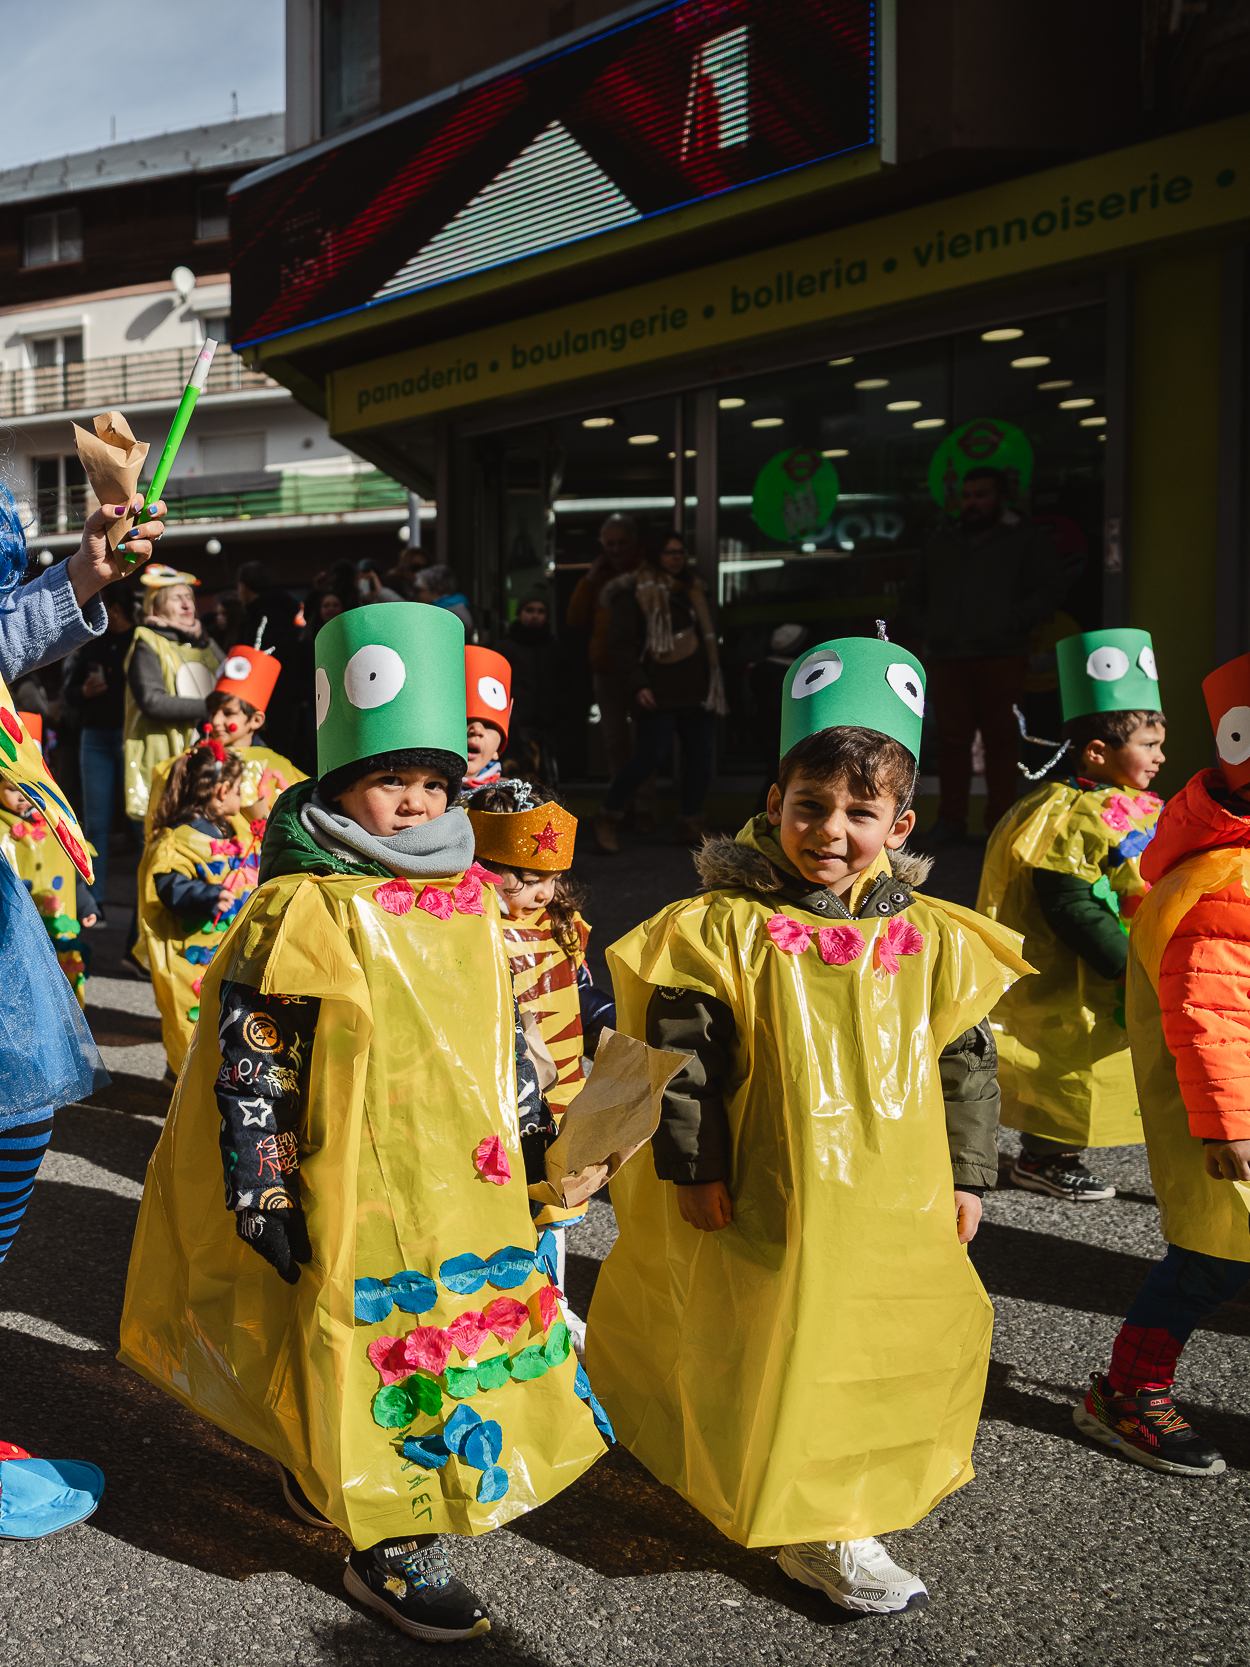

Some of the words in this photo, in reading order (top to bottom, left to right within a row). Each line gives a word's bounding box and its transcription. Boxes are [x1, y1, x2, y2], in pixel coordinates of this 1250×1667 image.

[356, 360, 478, 414] panaderia
[510, 304, 688, 371] boulangerie
[731, 257, 868, 316] bolleria
[912, 171, 1194, 269] viennoiserie
[384, 1541, 418, 1558] POKÉMON
